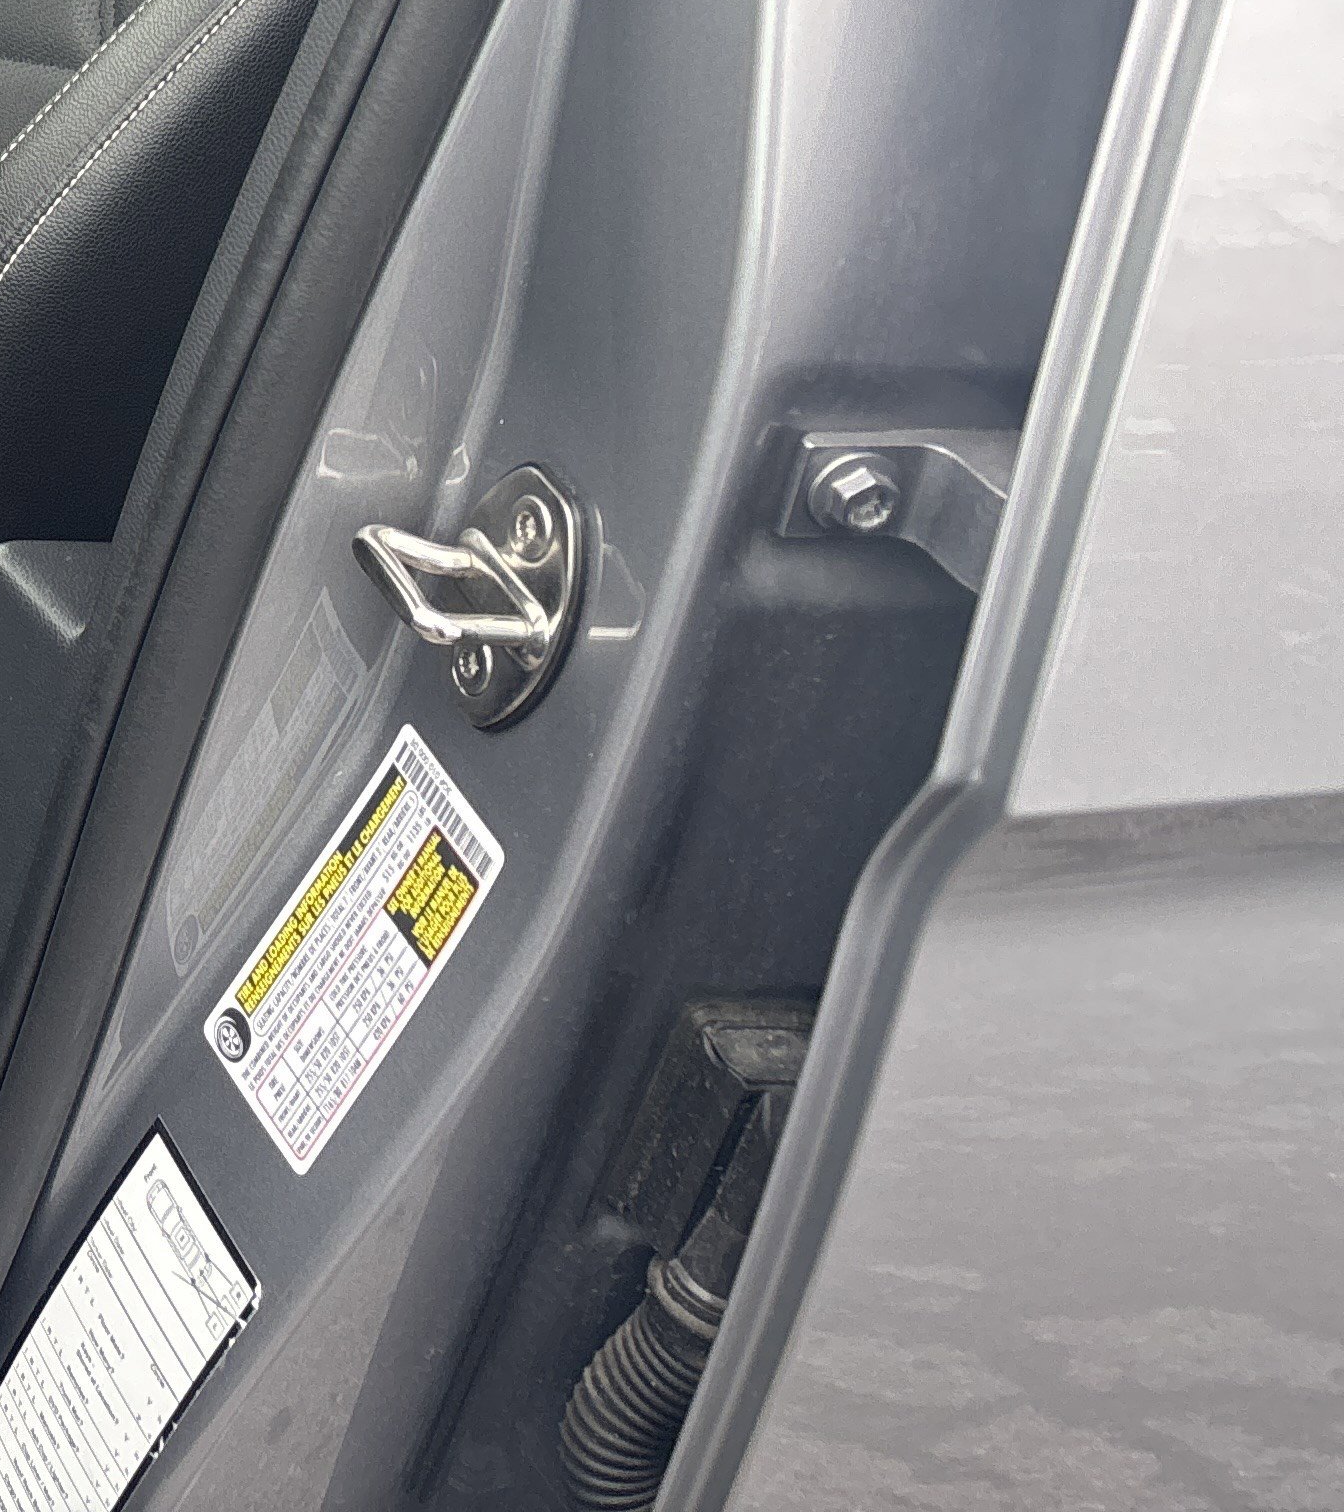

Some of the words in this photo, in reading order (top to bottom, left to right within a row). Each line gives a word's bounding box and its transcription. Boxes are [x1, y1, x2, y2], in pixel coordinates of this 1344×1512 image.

[236, 979, 253, 1005] TIRE
[248, 957, 269, 987] AND
[265, 914, 298, 963] LOADING
[294, 848, 343, 921] INFORMATION
[243, 929, 301, 1016] RENSEIGNEMENTS
[296, 910, 315, 936] SUR
[310, 893, 326, 917] LES
[321, 862, 347, 900] PNEUS
[342, 849, 356, 868] ET
[350, 837, 364, 857] LE
[357, 774, 406, 845] CHARGEMENT
